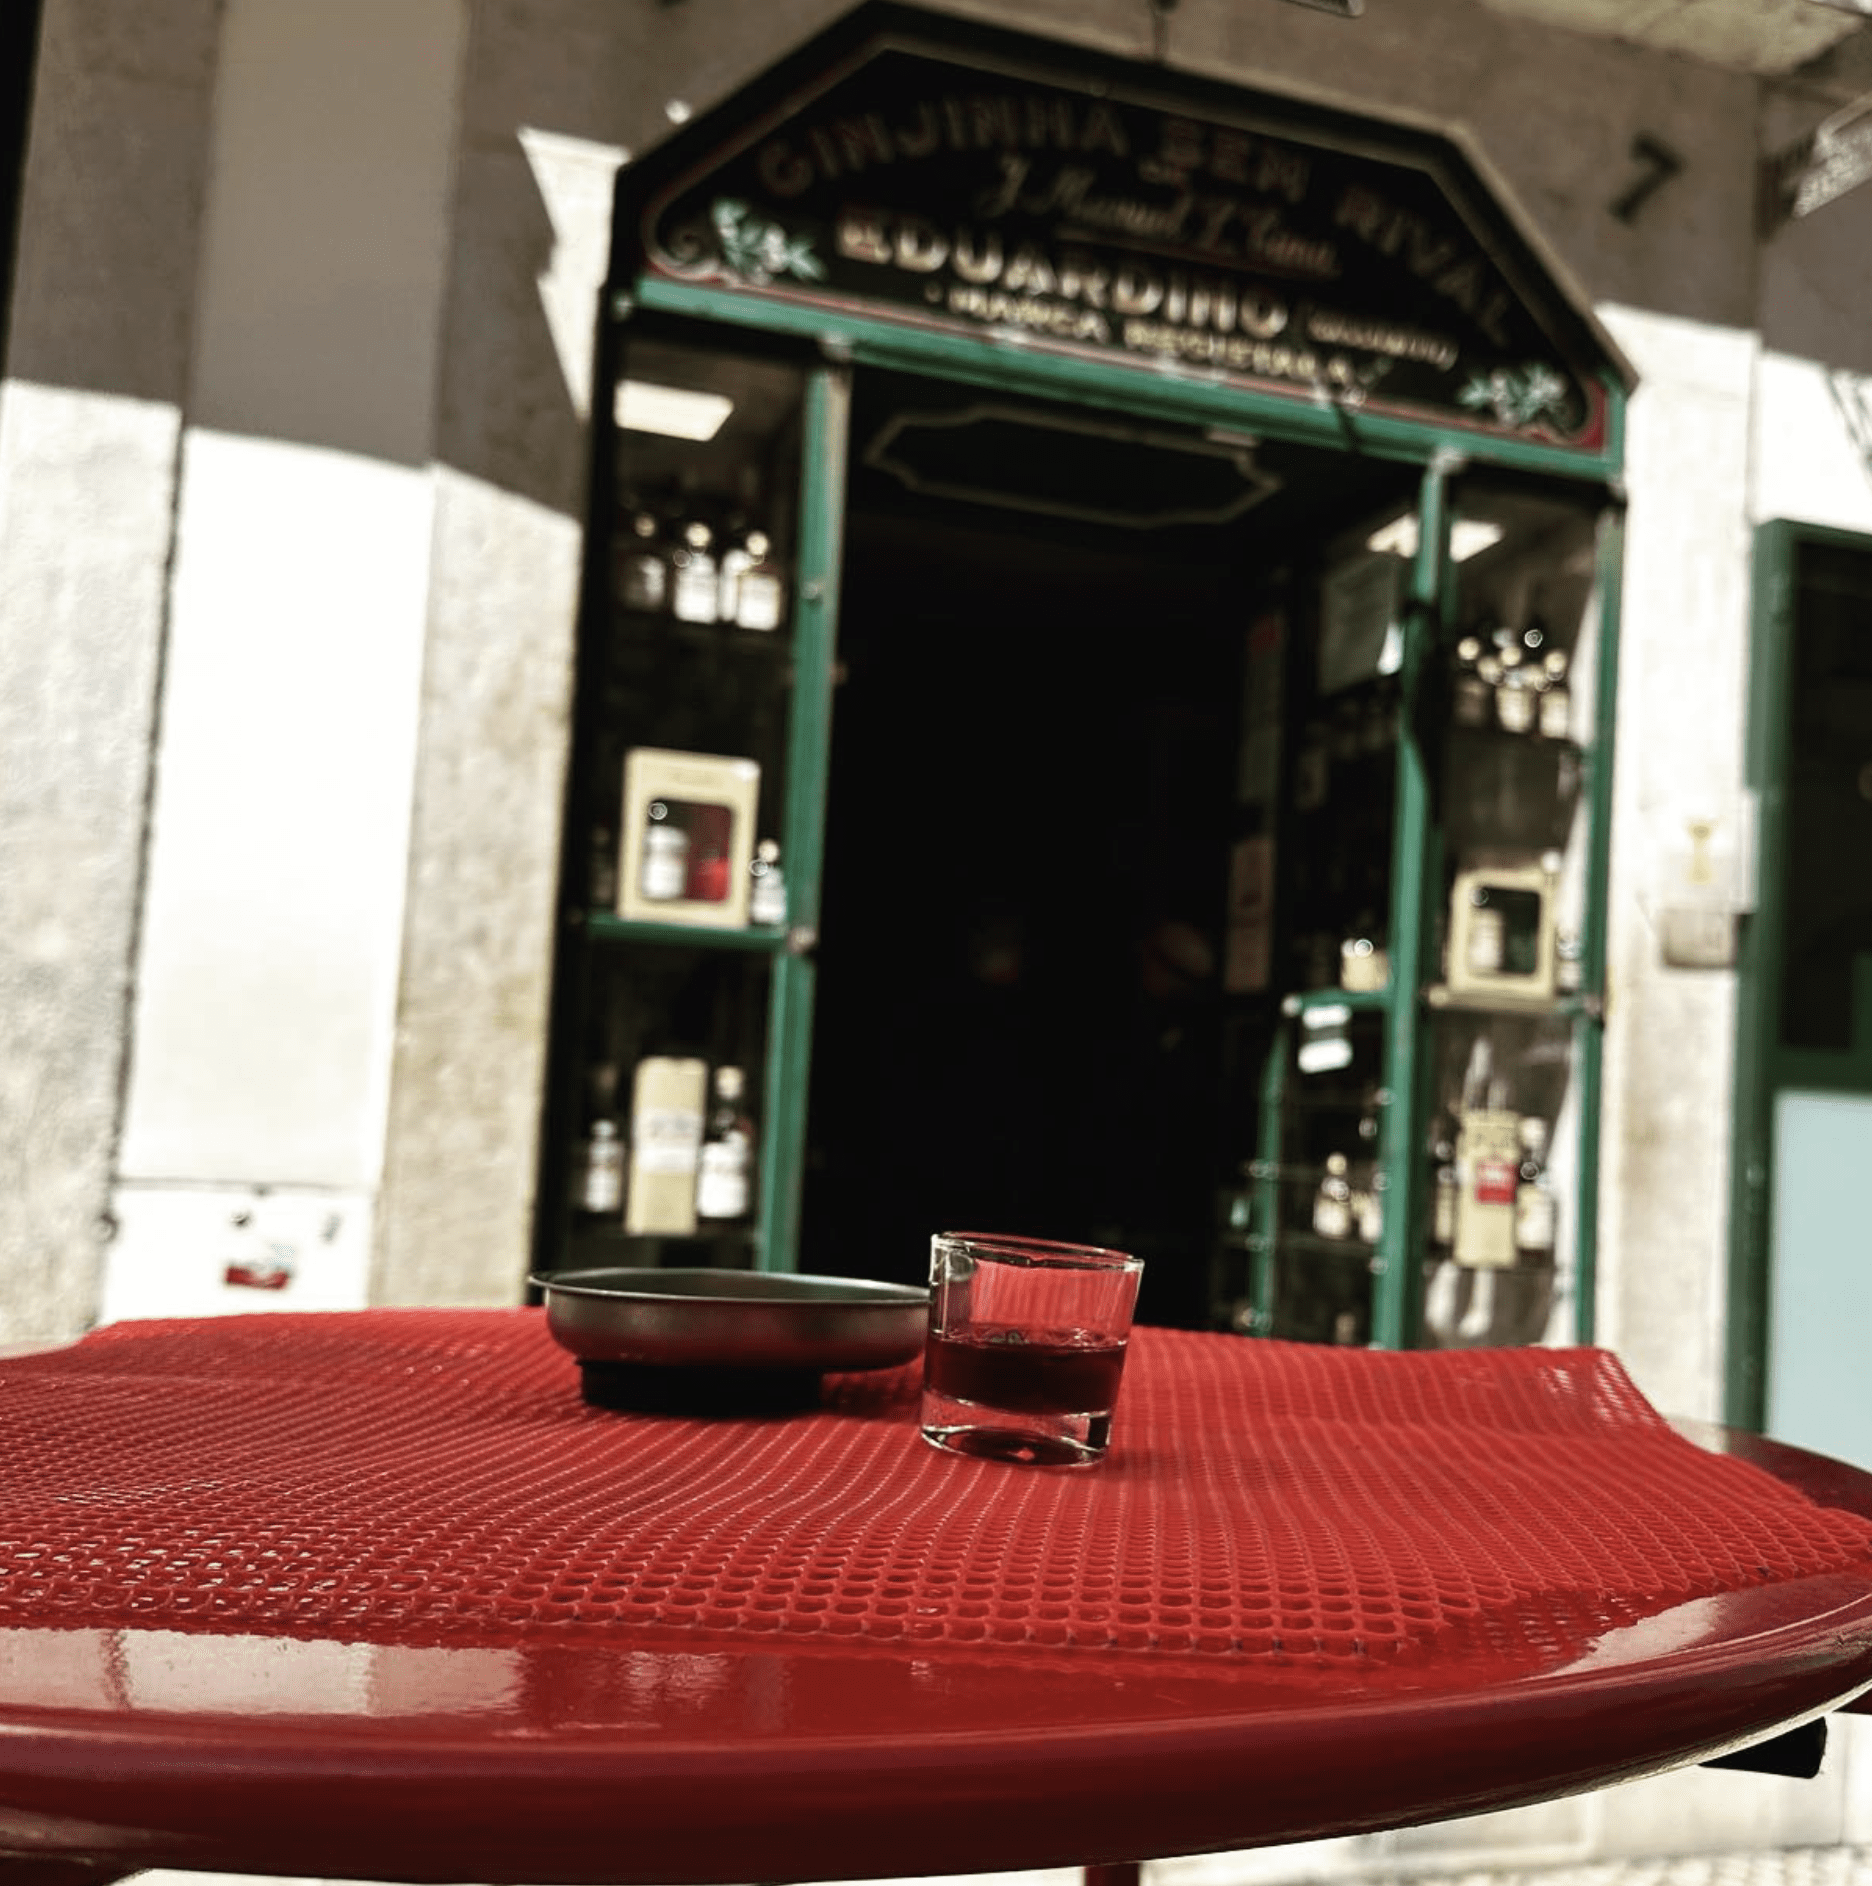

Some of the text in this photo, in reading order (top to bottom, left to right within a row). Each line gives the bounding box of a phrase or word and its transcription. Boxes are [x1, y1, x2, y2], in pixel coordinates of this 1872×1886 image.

[758, 97, 1131, 197] GINJINHA
[1159, 112, 1311, 203] SEM
[1333, 183, 1511, 350] RIVAL
[1610, 129, 1686, 229] 7
[835, 200, 1288, 338] EDUARDINO
[948, 287, 1109, 342] MARCA
